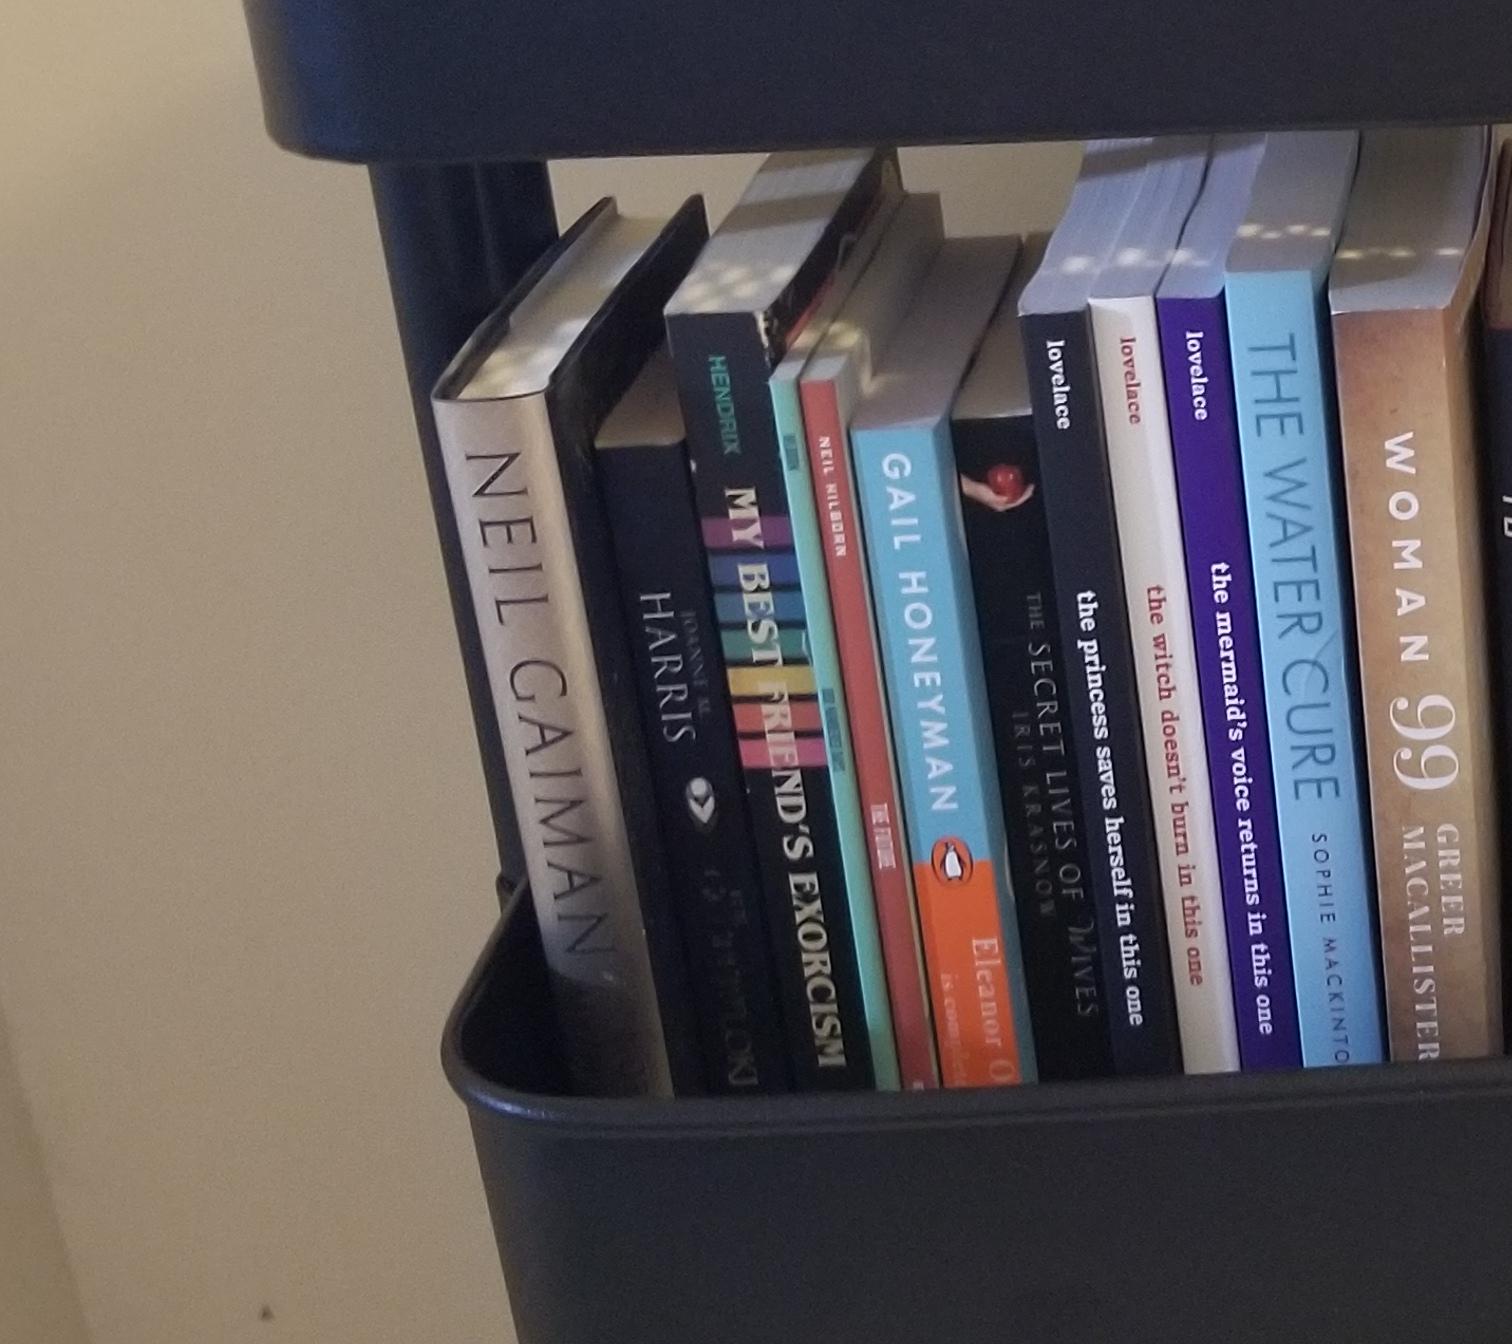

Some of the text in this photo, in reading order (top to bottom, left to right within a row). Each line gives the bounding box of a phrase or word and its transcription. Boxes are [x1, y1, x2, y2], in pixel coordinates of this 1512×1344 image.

[817, 435, 836, 475] NEIL
[1045, 338, 1071, 432] lovelace
[1118, 336, 1142, 426] lovelace
[1184, 329, 1209, 423] lovelace
[464, 450, 620, 956] NEIL GAIMAN
[639, 591, 698, 744] HARRIS
[723, 485, 848, 1069] MY BEST FRIEND'S EXORCISM
[880, 452, 961, 813] GAIL HONEYMAN
[1145, 582, 1204, 988] the witch doesn't burn in this one
[1246, 331, 1351, 1064] THE WATER CURE SOPHIE MACKINTO
[1383, 430, 1461, 792] WOMAN 99
[1027, 642, 1100, 1018] SECRET LIVES OF WIVES
[1075, 589, 1144, 1027] the princess saves herself in this one
[1209, 560, 1274, 1036] the mermaid's voice returns in this one
[1400, 825, 1441, 1061] MACALLISTER
[1434, 821, 1466, 937] GREER
[971, 935, 1003, 1047] Eleanor
